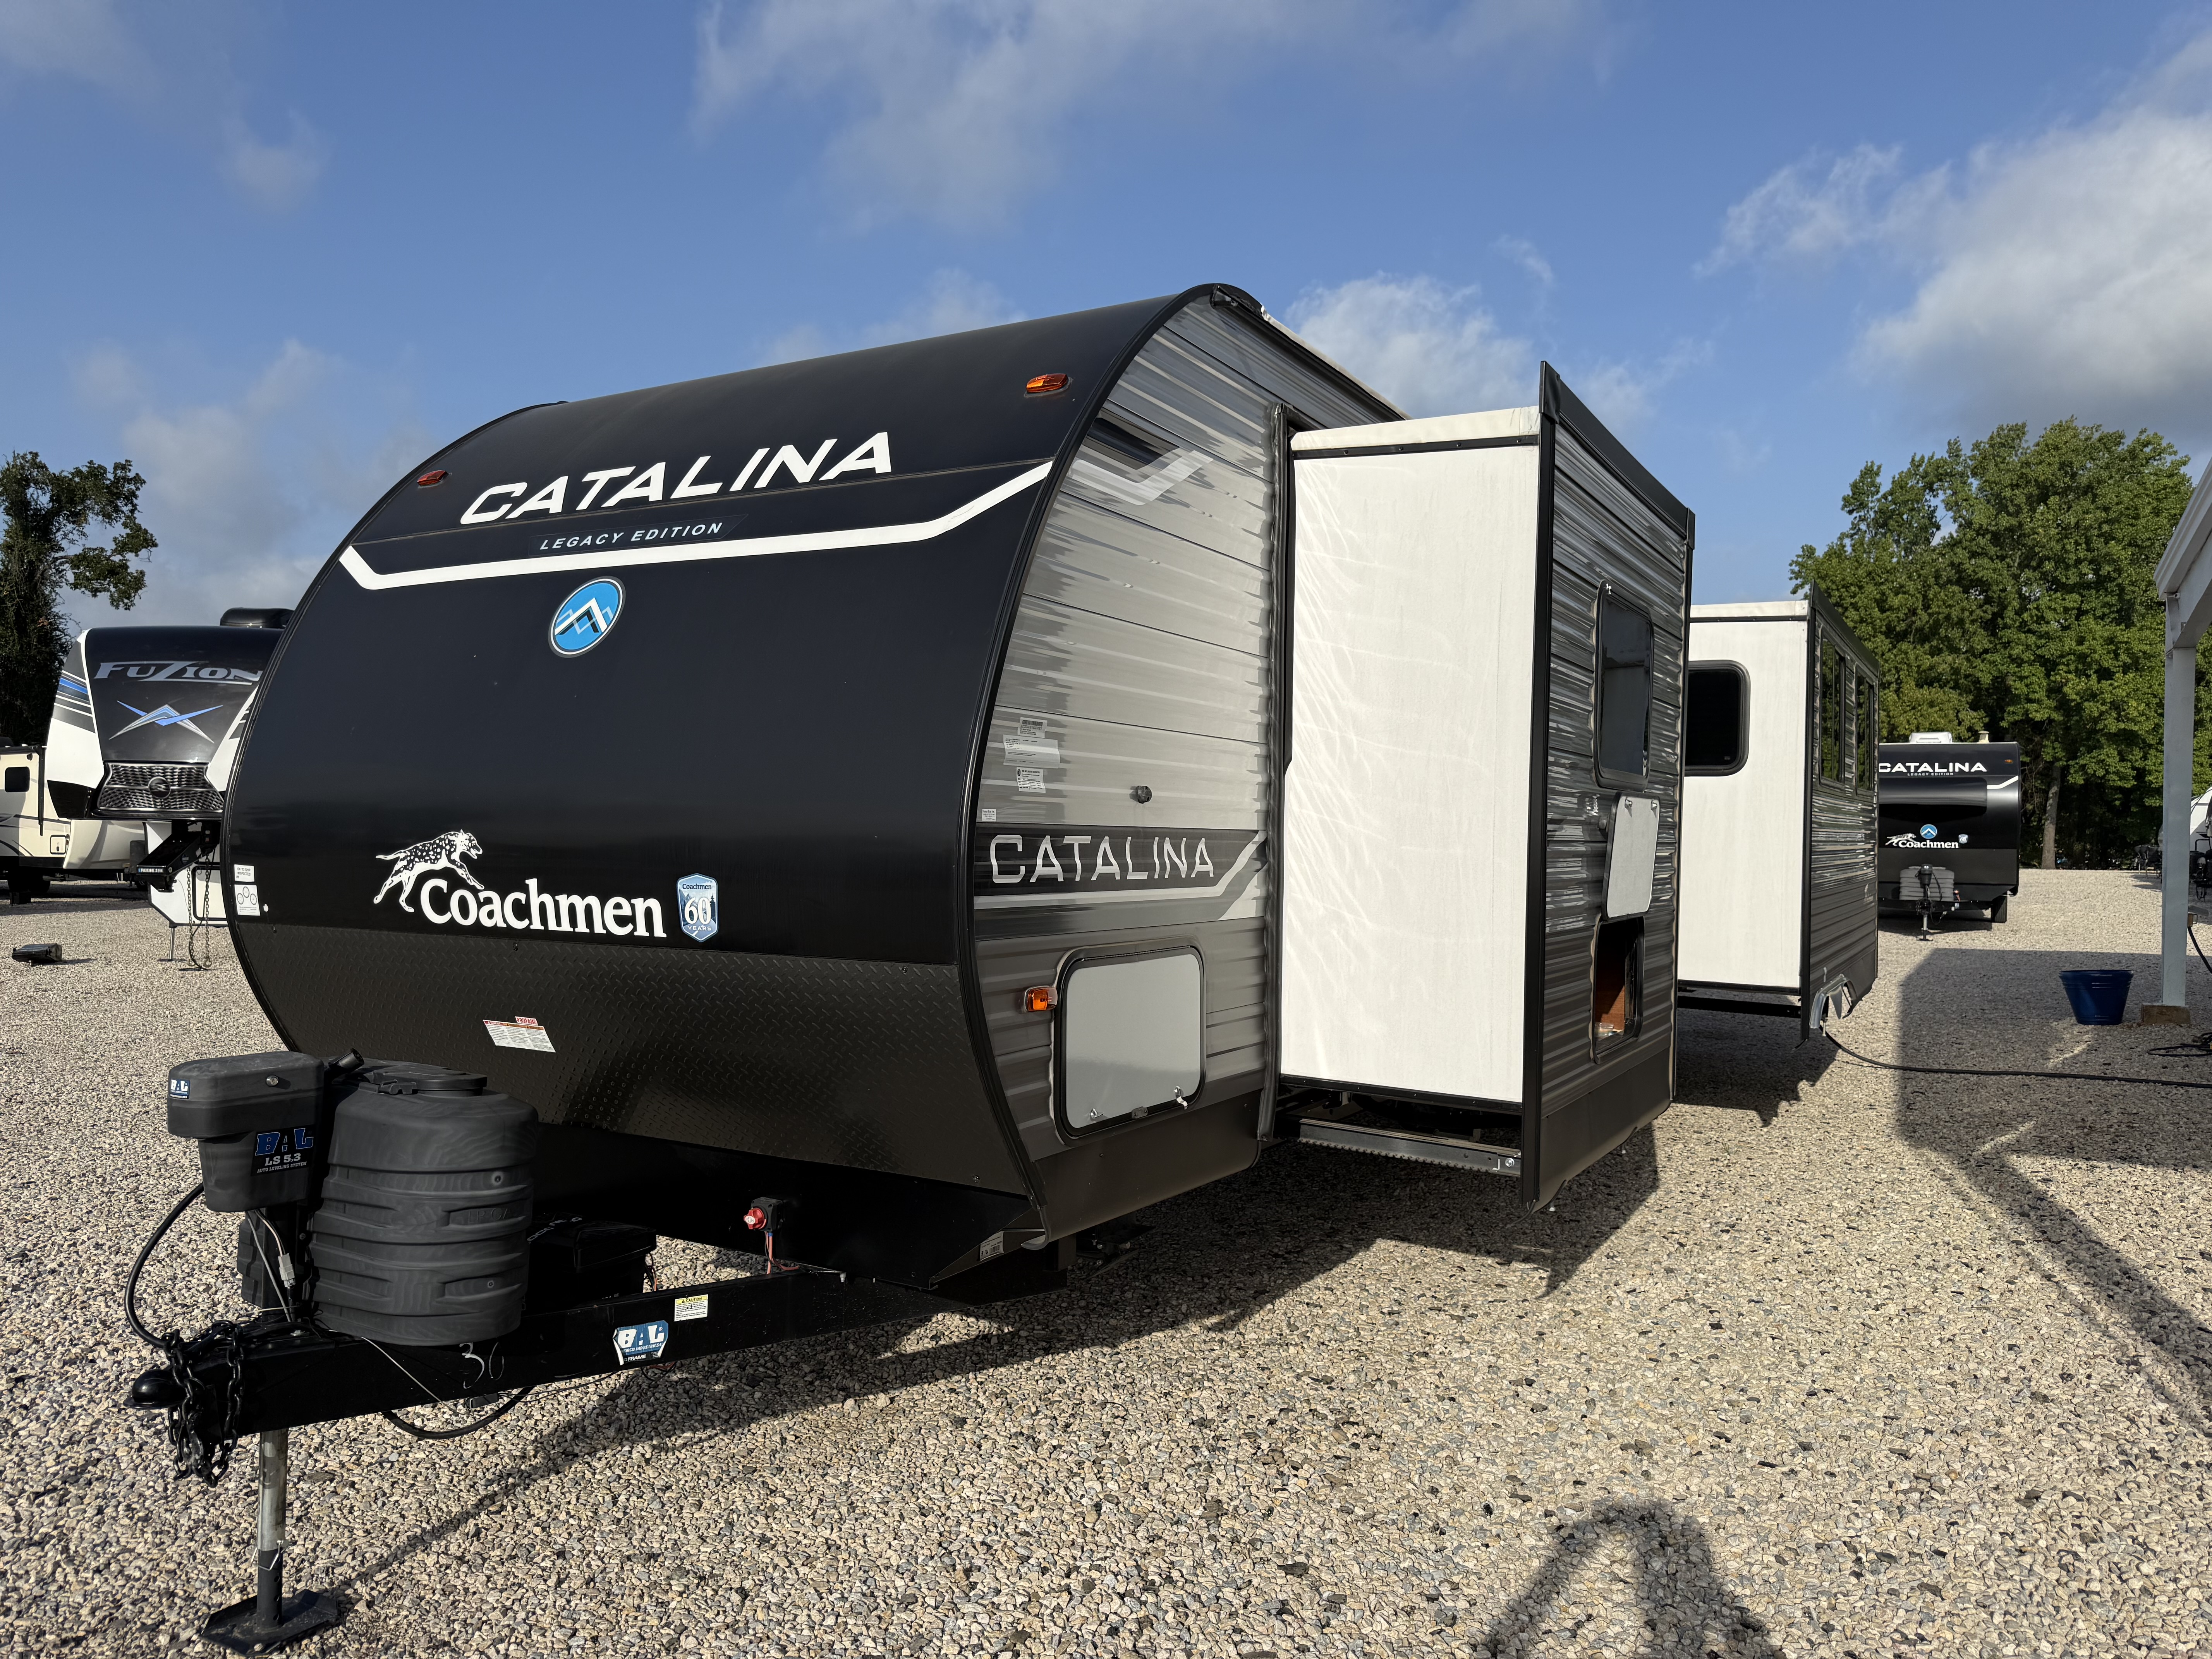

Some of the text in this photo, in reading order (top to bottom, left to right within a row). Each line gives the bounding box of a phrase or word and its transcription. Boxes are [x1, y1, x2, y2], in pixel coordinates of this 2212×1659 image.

[460, 432, 891, 524] CATALINA
[540, 522, 723, 550] LEGACY EDITION
[93, 661, 263, 685] FUZION
[1879, 762, 1987, 772] CATALINA
[1898, 840, 1959, 848] Coachmen
[990, 835, 1214, 883] CATALINA
[421, 878, 667, 937] Coachmen
[684, 897, 711, 924] 60
[264, 1153, 301, 1166] LS 5.3
